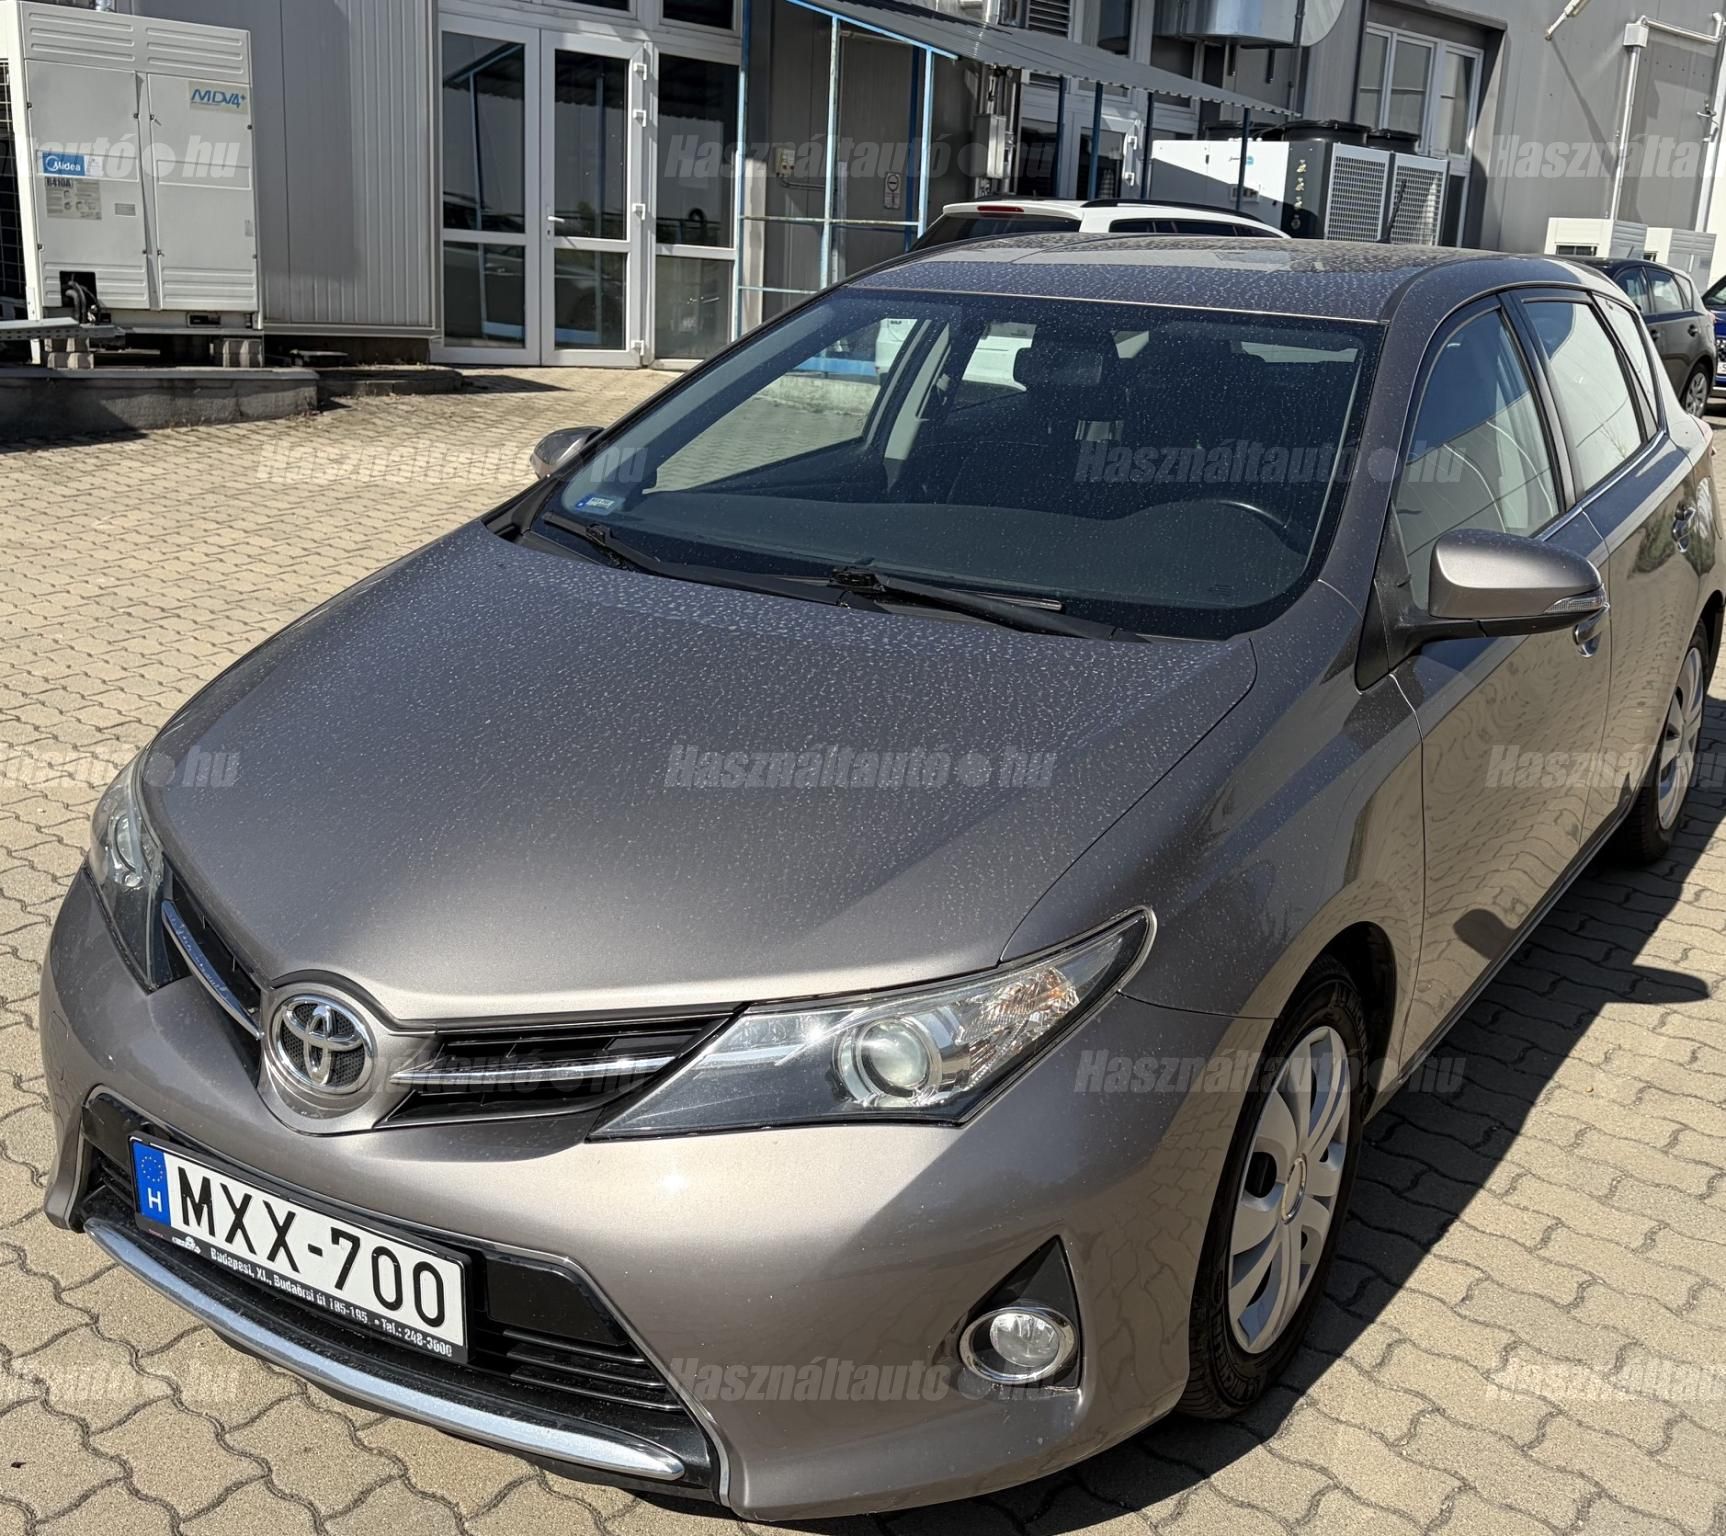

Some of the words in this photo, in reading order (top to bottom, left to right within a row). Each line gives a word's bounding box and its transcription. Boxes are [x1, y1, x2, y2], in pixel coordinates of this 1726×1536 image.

[46, 156, 81, 172] Midea
[148, 1187, 162, 1213] H
[178, 1165, 446, 1328] MXX-700
